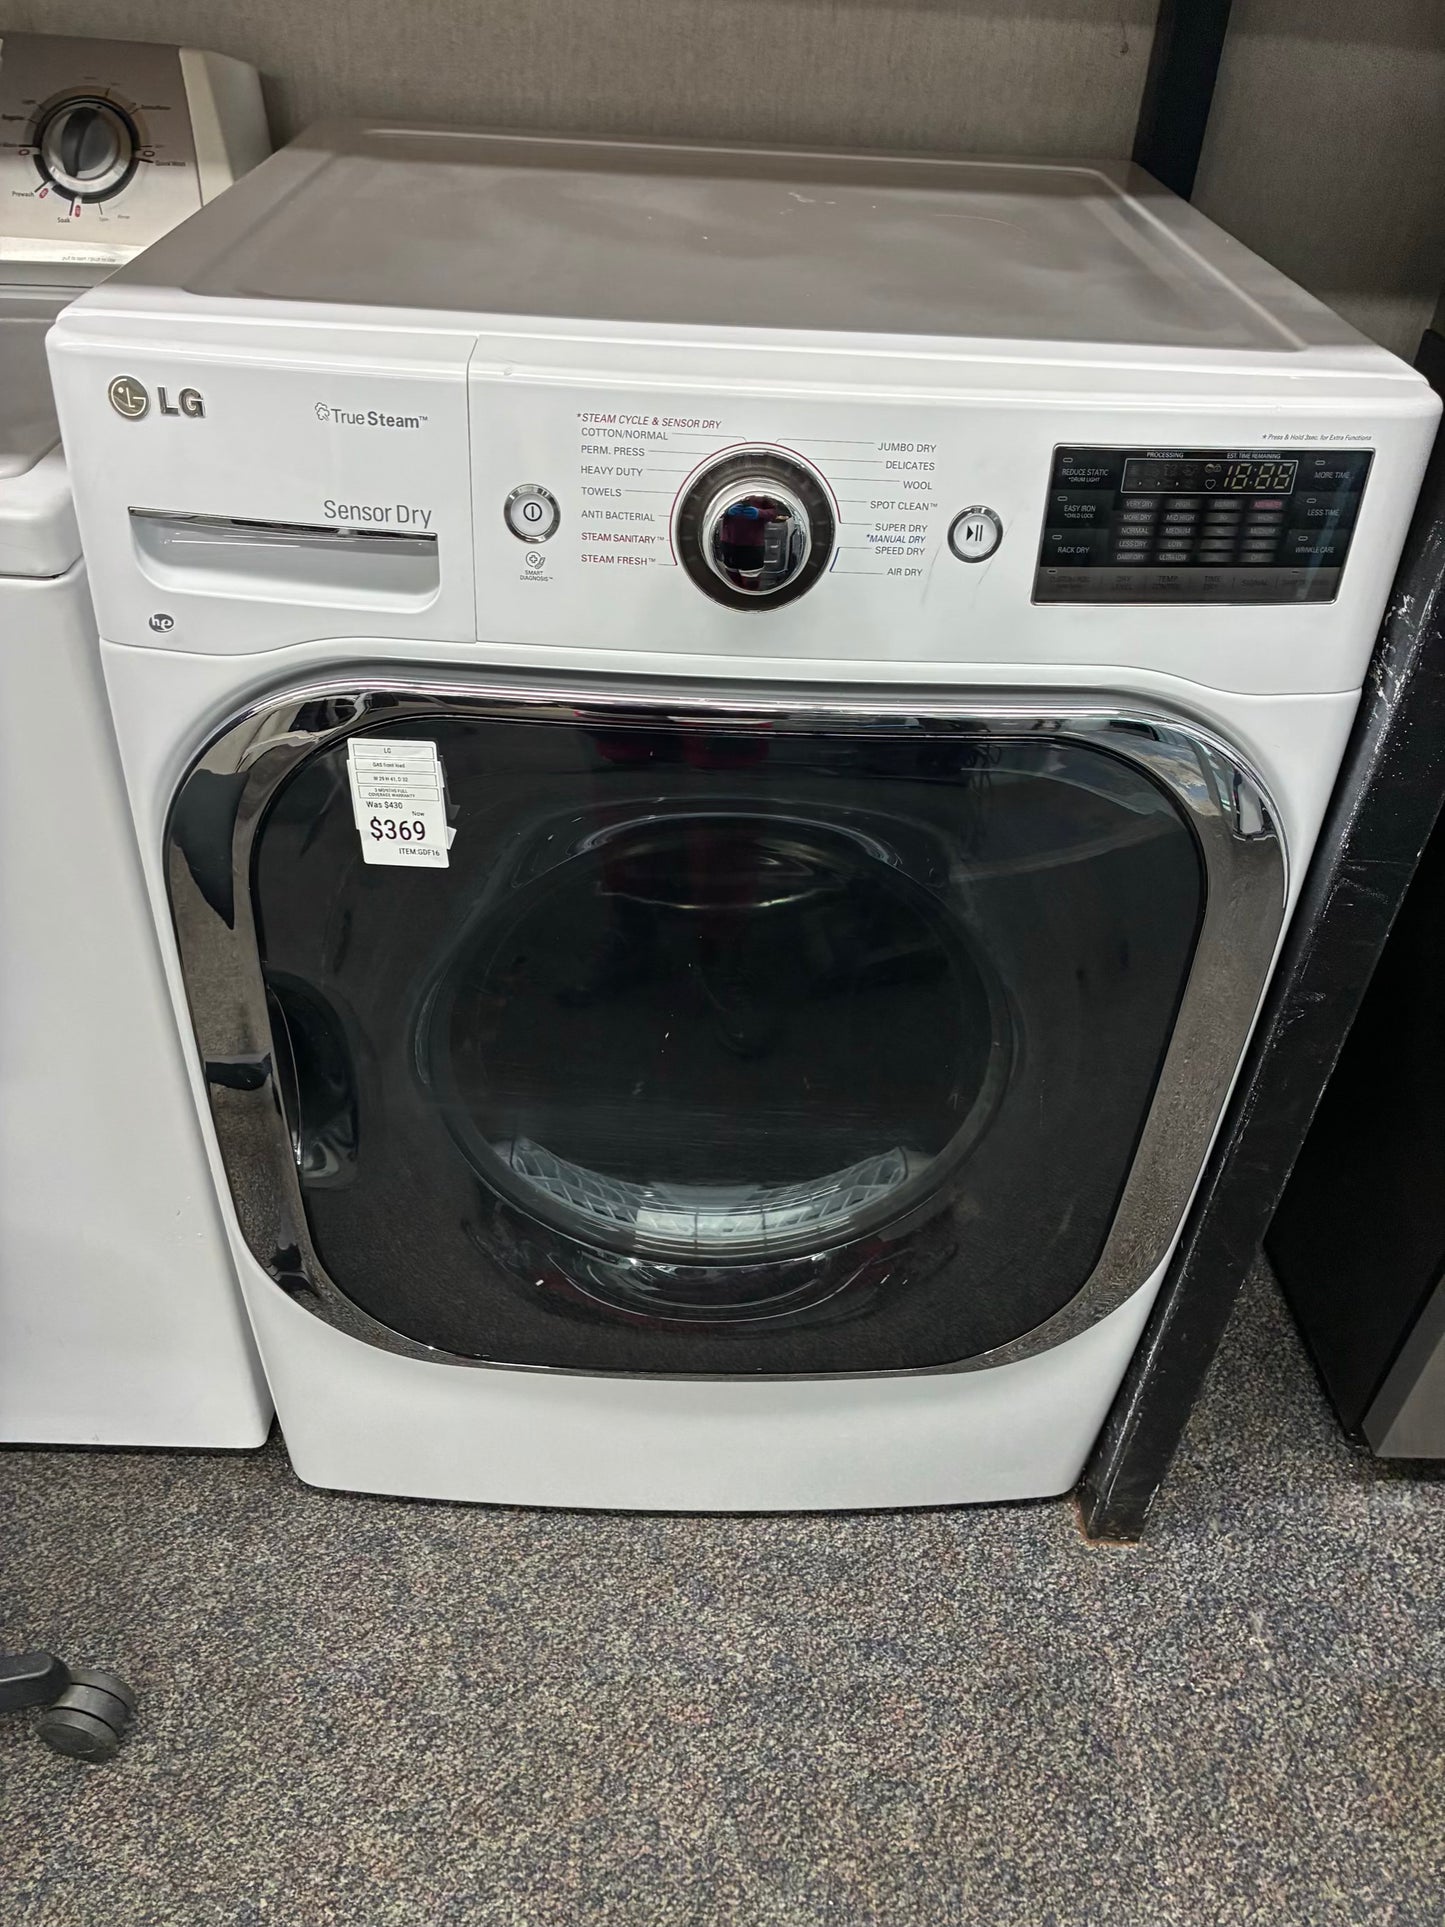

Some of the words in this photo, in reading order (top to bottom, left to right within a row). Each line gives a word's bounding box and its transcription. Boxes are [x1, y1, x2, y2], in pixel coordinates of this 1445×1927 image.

[157, 386, 206, 418] LG
[619, 415, 649, 426] CYCLE
[652, 416, 660, 426] &
[661, 418, 700, 428] SENSOR
[702, 419, 722, 429] DRY
[581, 427, 669, 440] COTTON/NORMAL
[581, 445, 611, 455] PERM.
[614, 446, 645, 457] PRESS
[878, 442, 914, 452] JUMBO
[916, 444, 937, 453] DRY
[885, 460, 935, 471] DELICATES
[581, 465, 614, 476] HEAVY
[616, 467, 643, 477] DUTY
[1062, 468, 1086, 476] REDUCE
[903, 480, 933, 490] WOOL
[581, 487, 622, 497] TOWELS
[870, 500, 896, 510] SPOT
[323, 500, 393, 523] Sensor
[397, 504, 432, 529] Dry
[581, 510, 603, 519] ANTI
[605, 511, 655, 522] BACTERIAL
[875, 523, 906, 532] SUPER
[908, 524, 928, 533] DRY
[581, 532, 612, 542] STEAM
[908, 535, 926, 544] DRY
[875, 546, 904, 555] SPEED
[906, 547, 925, 556] DRY
[581, 554, 615, 564] STEAM
[887, 568, 902, 576] AIR
[904, 568, 923, 577] DRY
[384, 801, 403, 809] $430
[370, 816, 426, 841] $369
